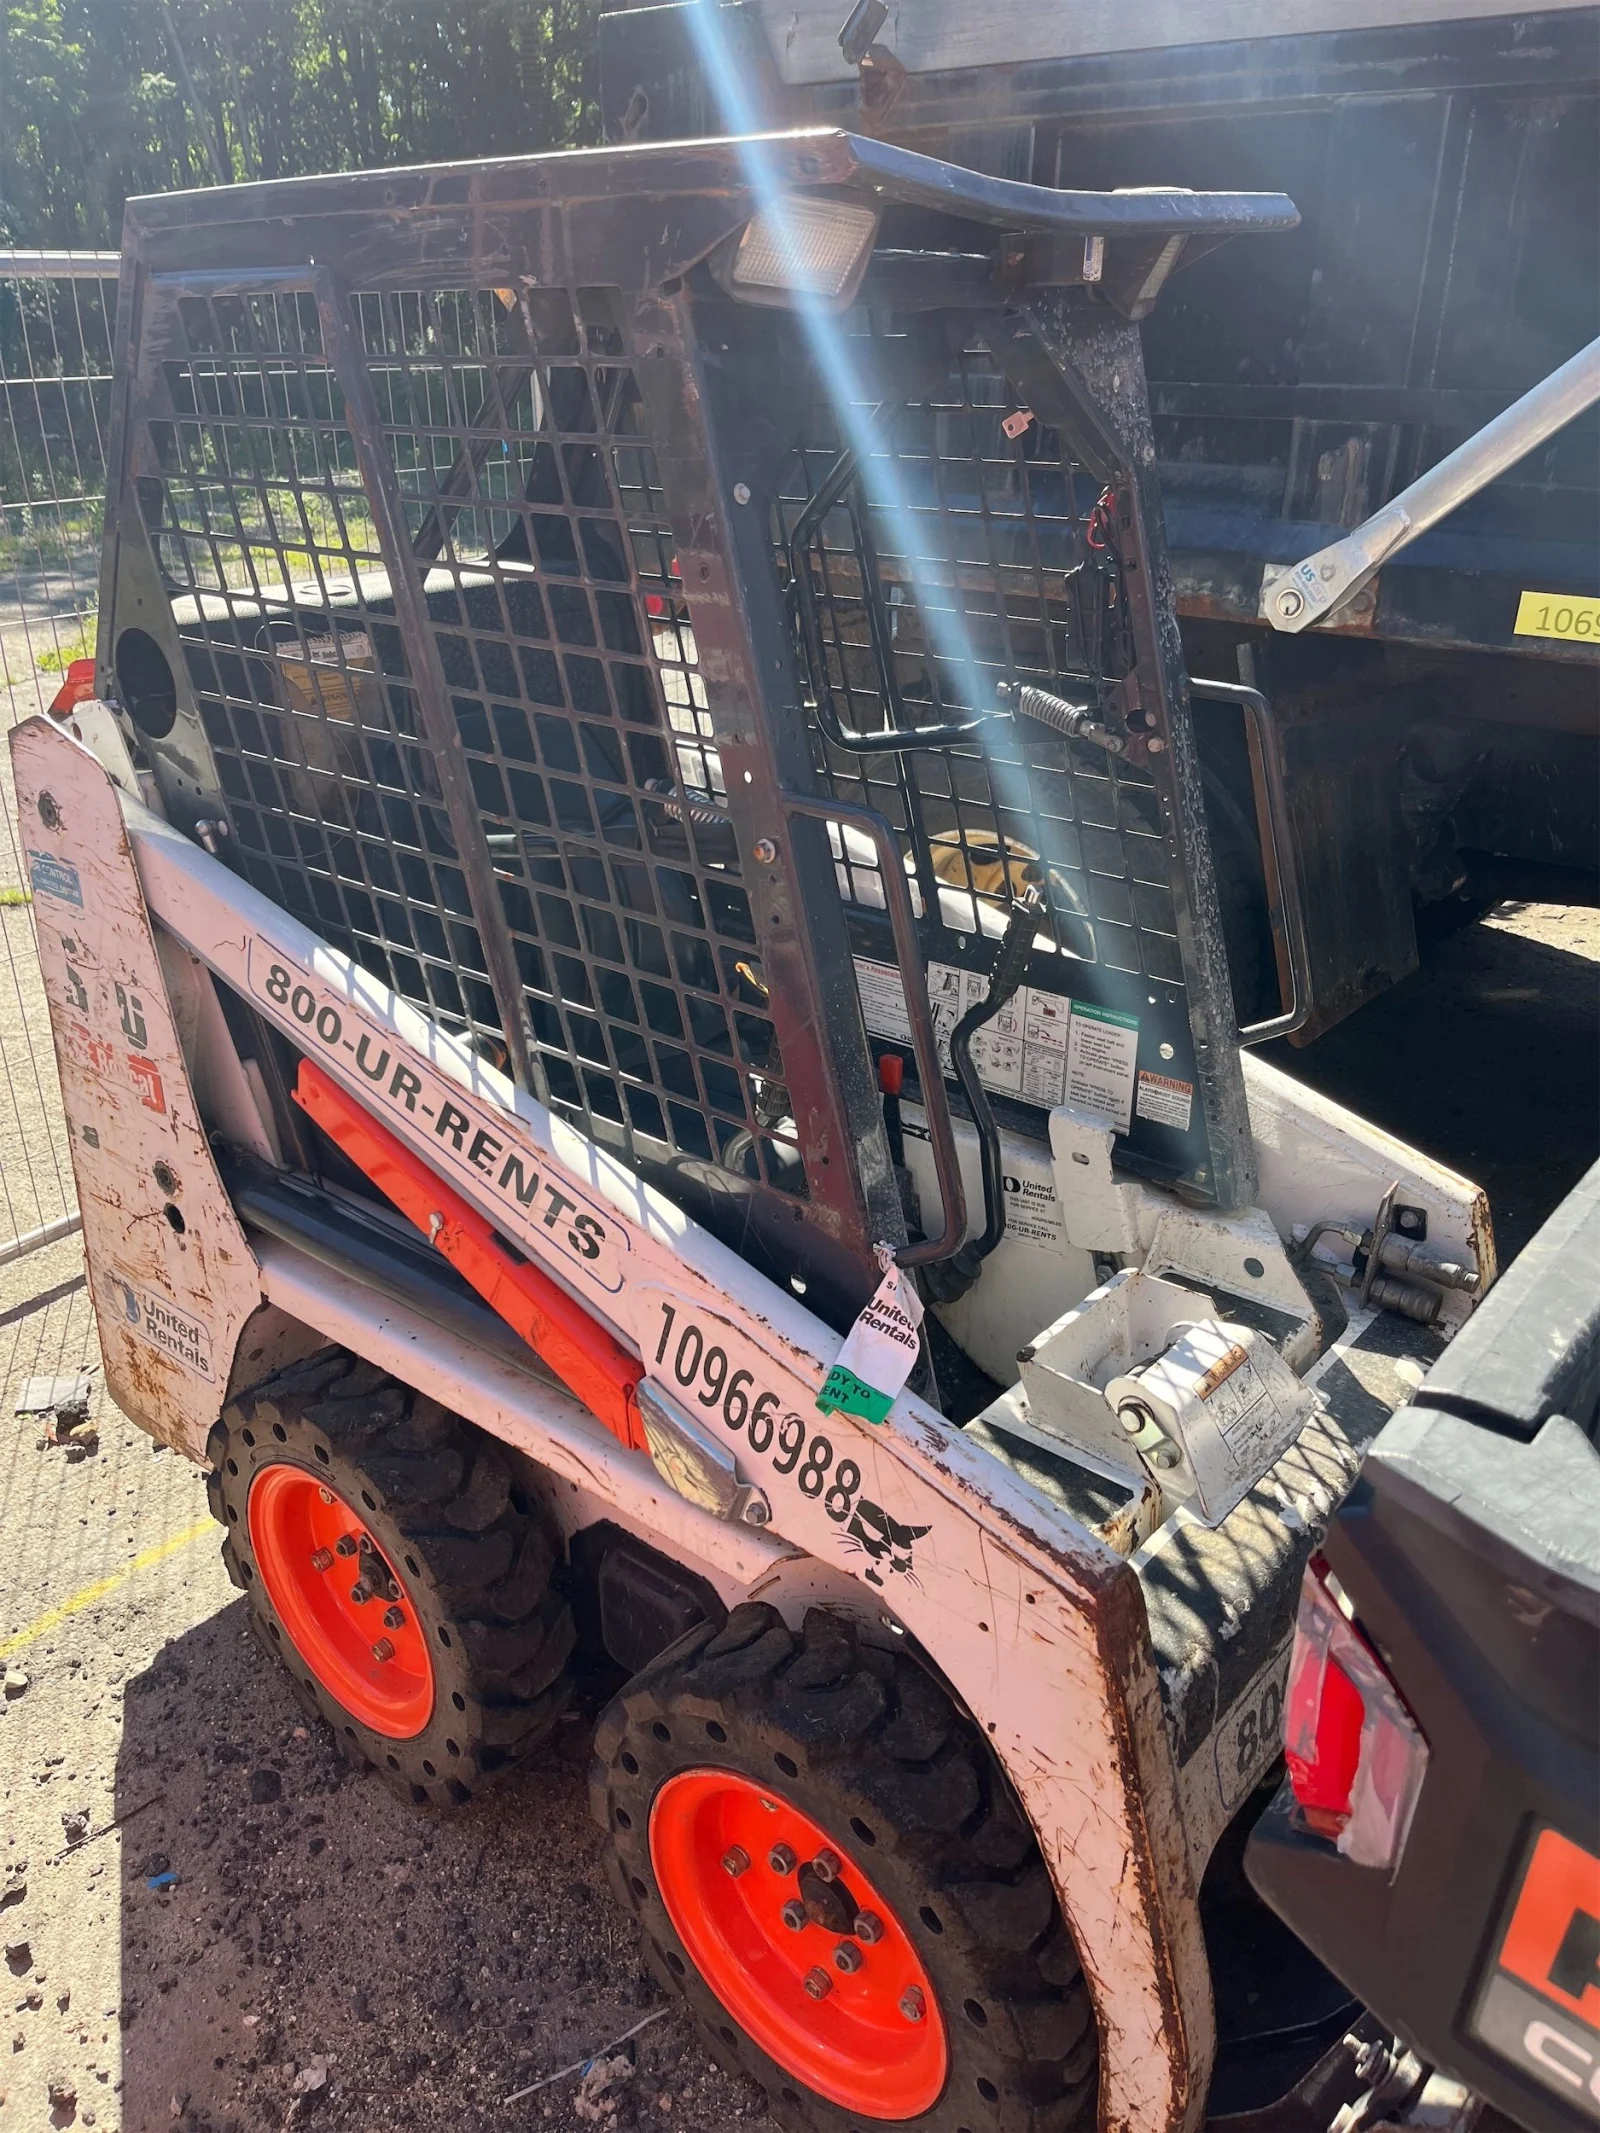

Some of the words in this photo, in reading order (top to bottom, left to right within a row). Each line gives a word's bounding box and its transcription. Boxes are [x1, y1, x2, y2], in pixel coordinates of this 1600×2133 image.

[1301, 563, 1315, 582] US
[1073, 1004, 1102, 1016] OPERATION
[1101, 1012, 1138, 1026] INSTRUCTIONS
[1082, 1023, 1102, 1033] OPERATE
[1149, 1073, 1191, 1094] WARNING
[265, 963, 606, 1261] 800-UR-RENTS
[1022, 1180, 1053, 1194] United
[1022, 1188, 1056, 1202] Rentals
[143, 1293, 199, 1346] United
[859, 1310, 918, 1350] Rentals
[146, 1316, 209, 1373] Rentals
[821, 1384, 849, 1404] ENT
[829, 1370, 851, 1387] DY
[852, 1384, 871, 1399] TO
[655, 1302, 861, 1523] 10966988
[1236, 1680, 1284, 1777] 80
